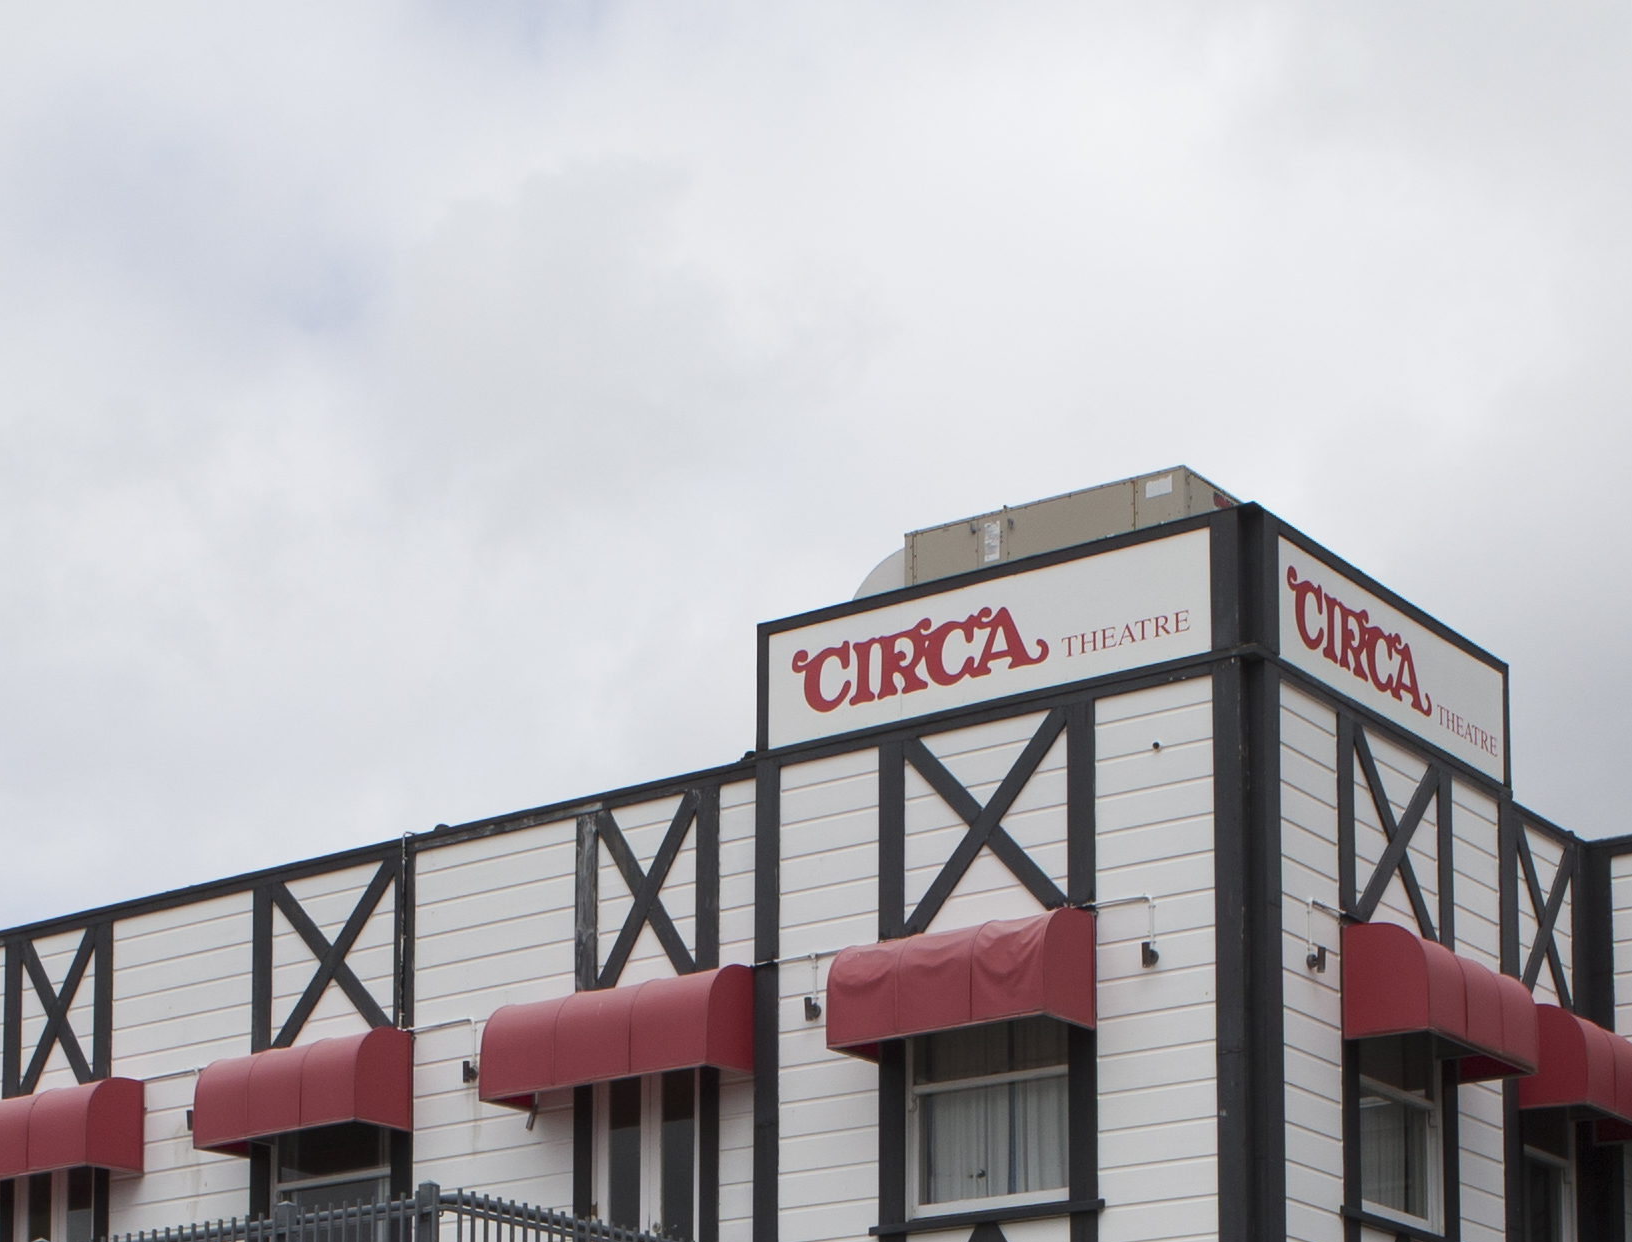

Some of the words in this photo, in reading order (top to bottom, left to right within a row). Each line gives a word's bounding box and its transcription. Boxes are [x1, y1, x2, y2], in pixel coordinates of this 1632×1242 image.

[792, 606, 1050, 713] CIRCA
[1061, 609, 1191, 658] THEATRE
[1287, 565, 1433, 718] CIRCA
[1436, 704, 1498, 758] THEATRE
